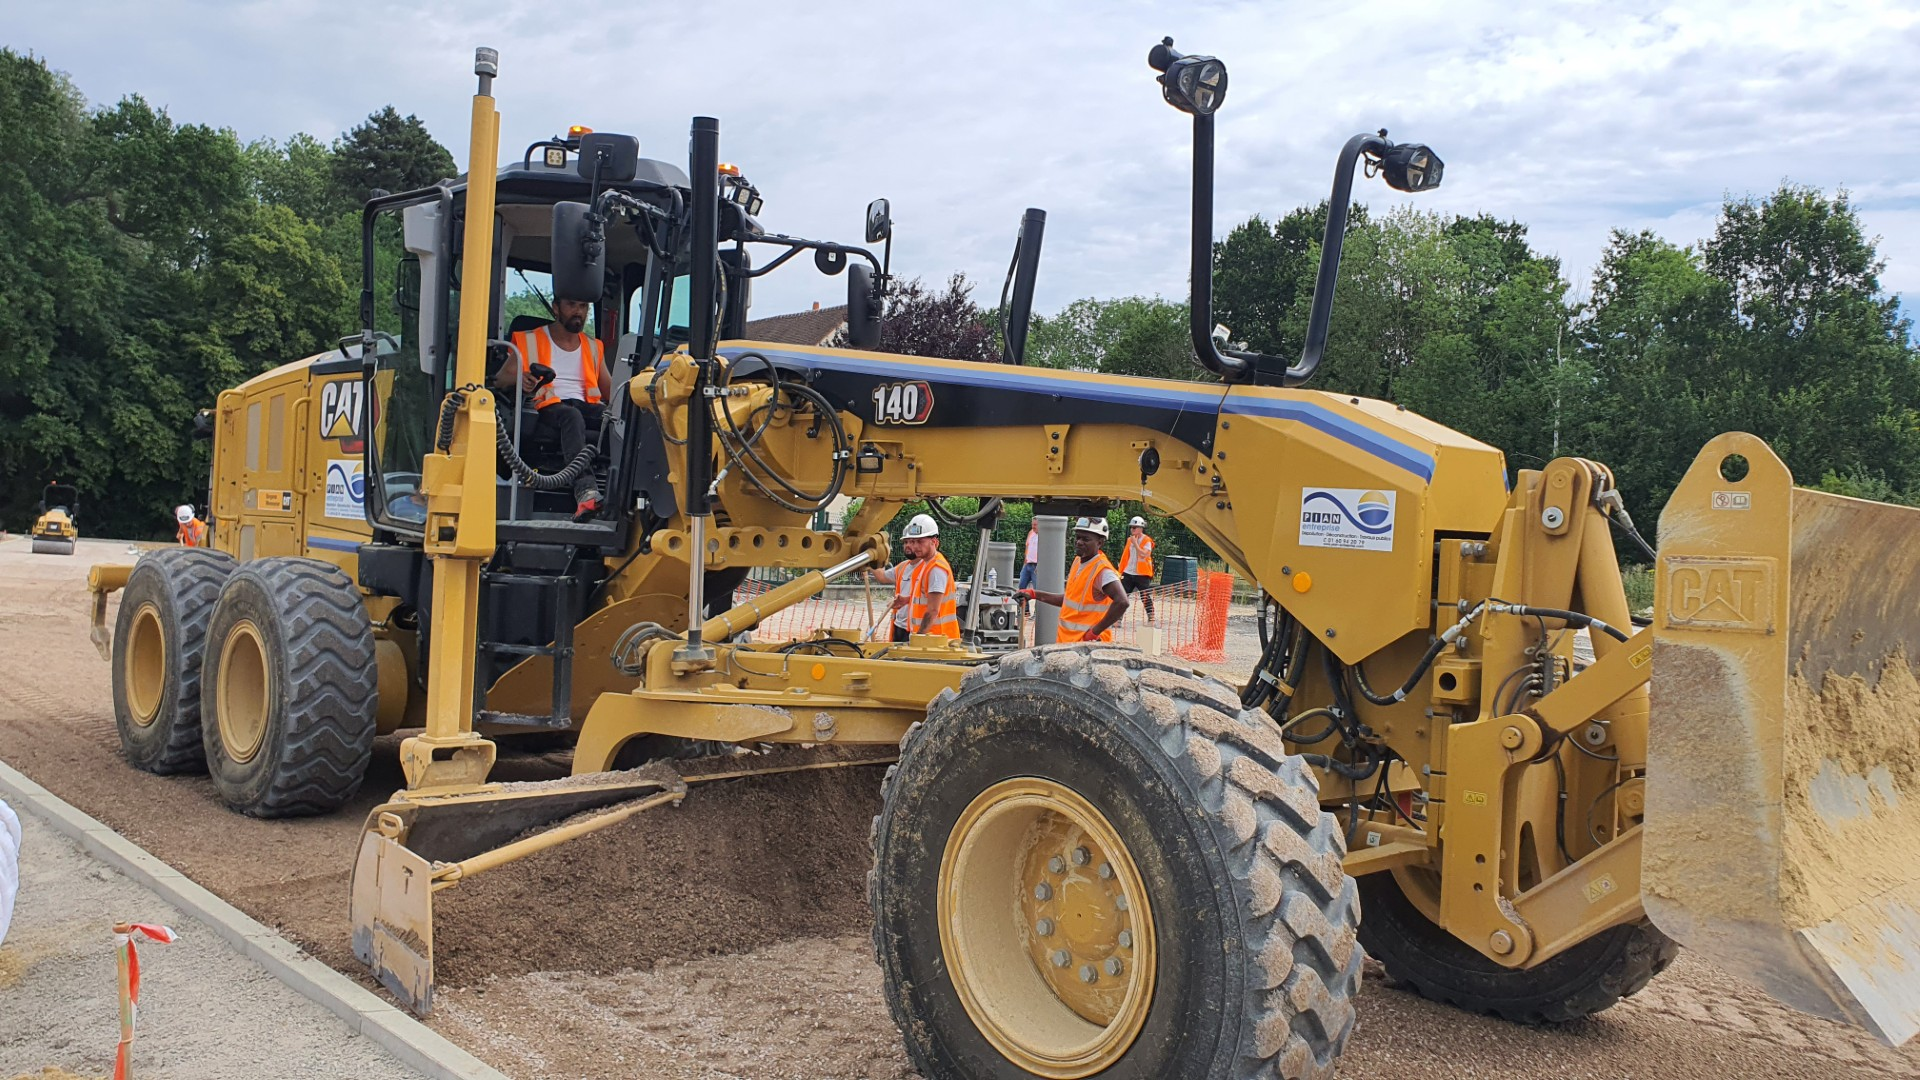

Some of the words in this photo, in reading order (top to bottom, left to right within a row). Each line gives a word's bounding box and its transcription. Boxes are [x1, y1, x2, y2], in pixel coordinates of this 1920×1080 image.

[321, 381, 364, 437] CAT
[874, 384, 918, 420] 140
[1302, 523, 1340, 532] entreprise
[1303, 512, 1340, 524] PIAN
[1671, 568, 1764, 622] CAT
